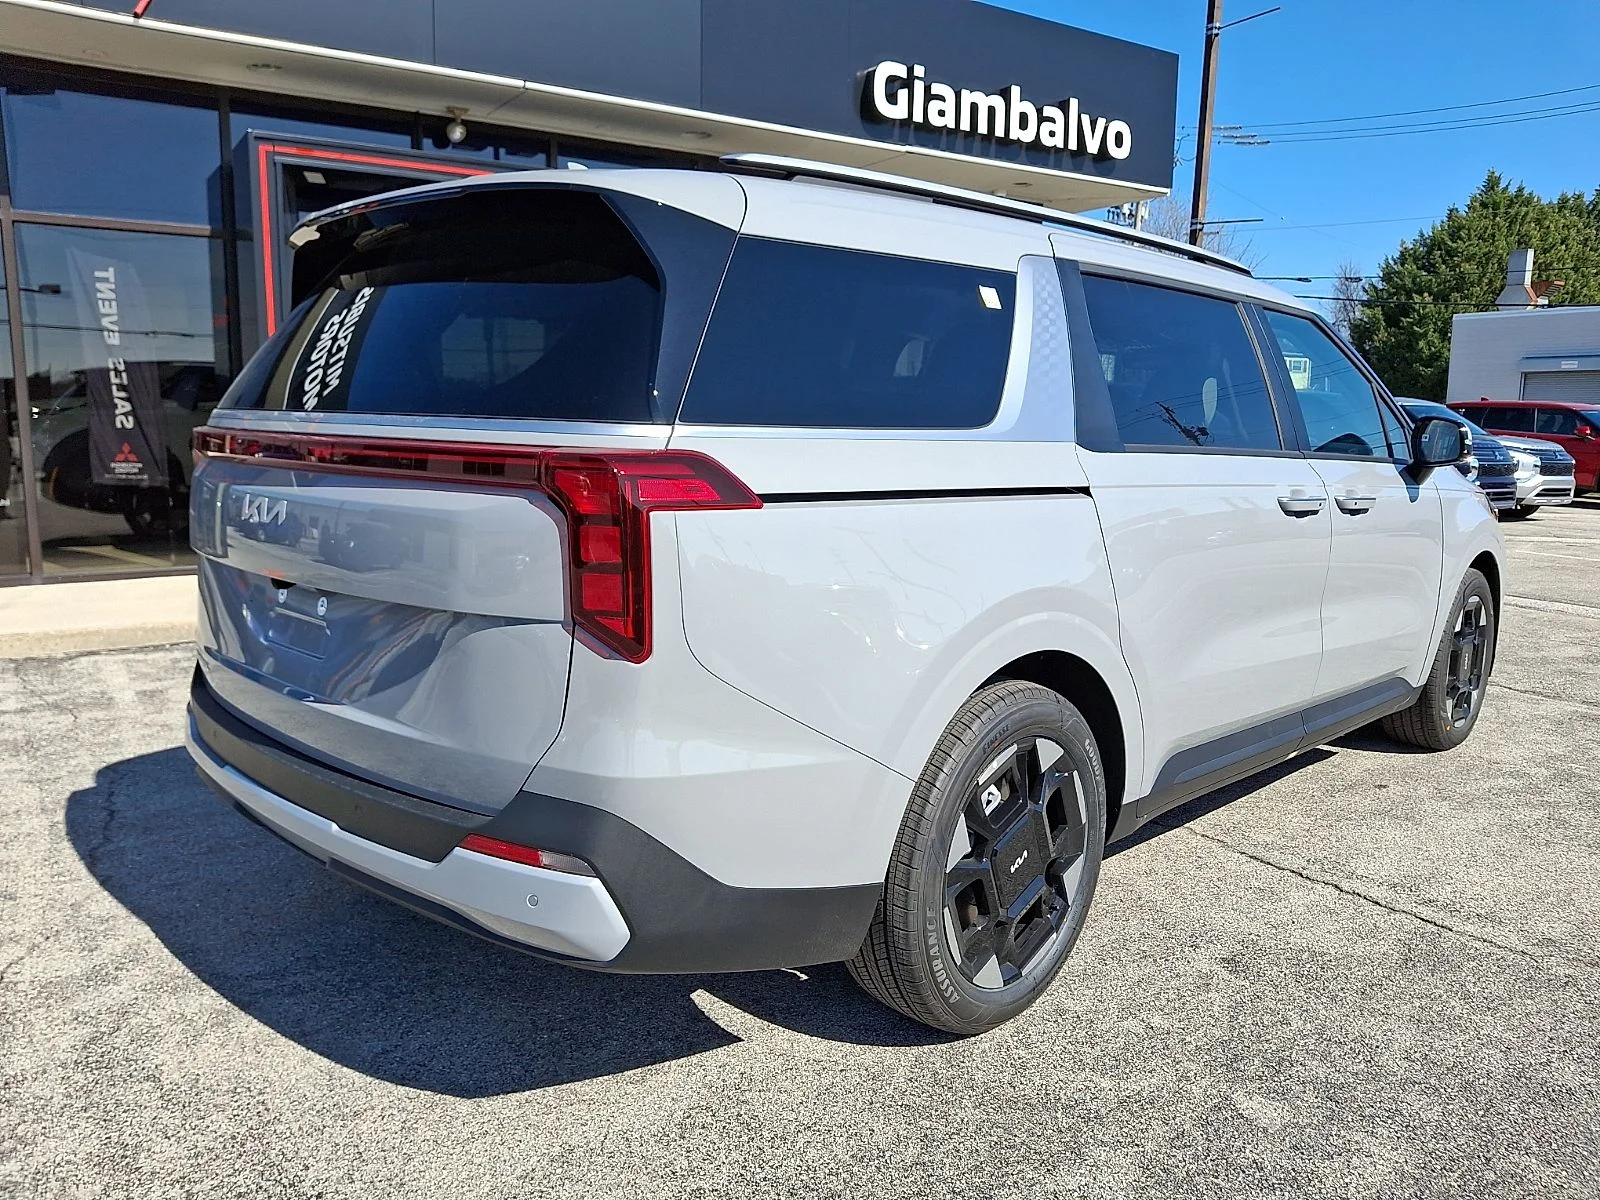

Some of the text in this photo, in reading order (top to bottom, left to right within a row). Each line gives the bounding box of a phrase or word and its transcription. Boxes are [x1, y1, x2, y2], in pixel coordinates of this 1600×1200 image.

[873, 60, 1133, 161] Giambalvo
[241, 493, 287, 525] KIA
[1010, 849, 1028, 874] KIA
[926, 906, 961, 1004] ASSURANCE
